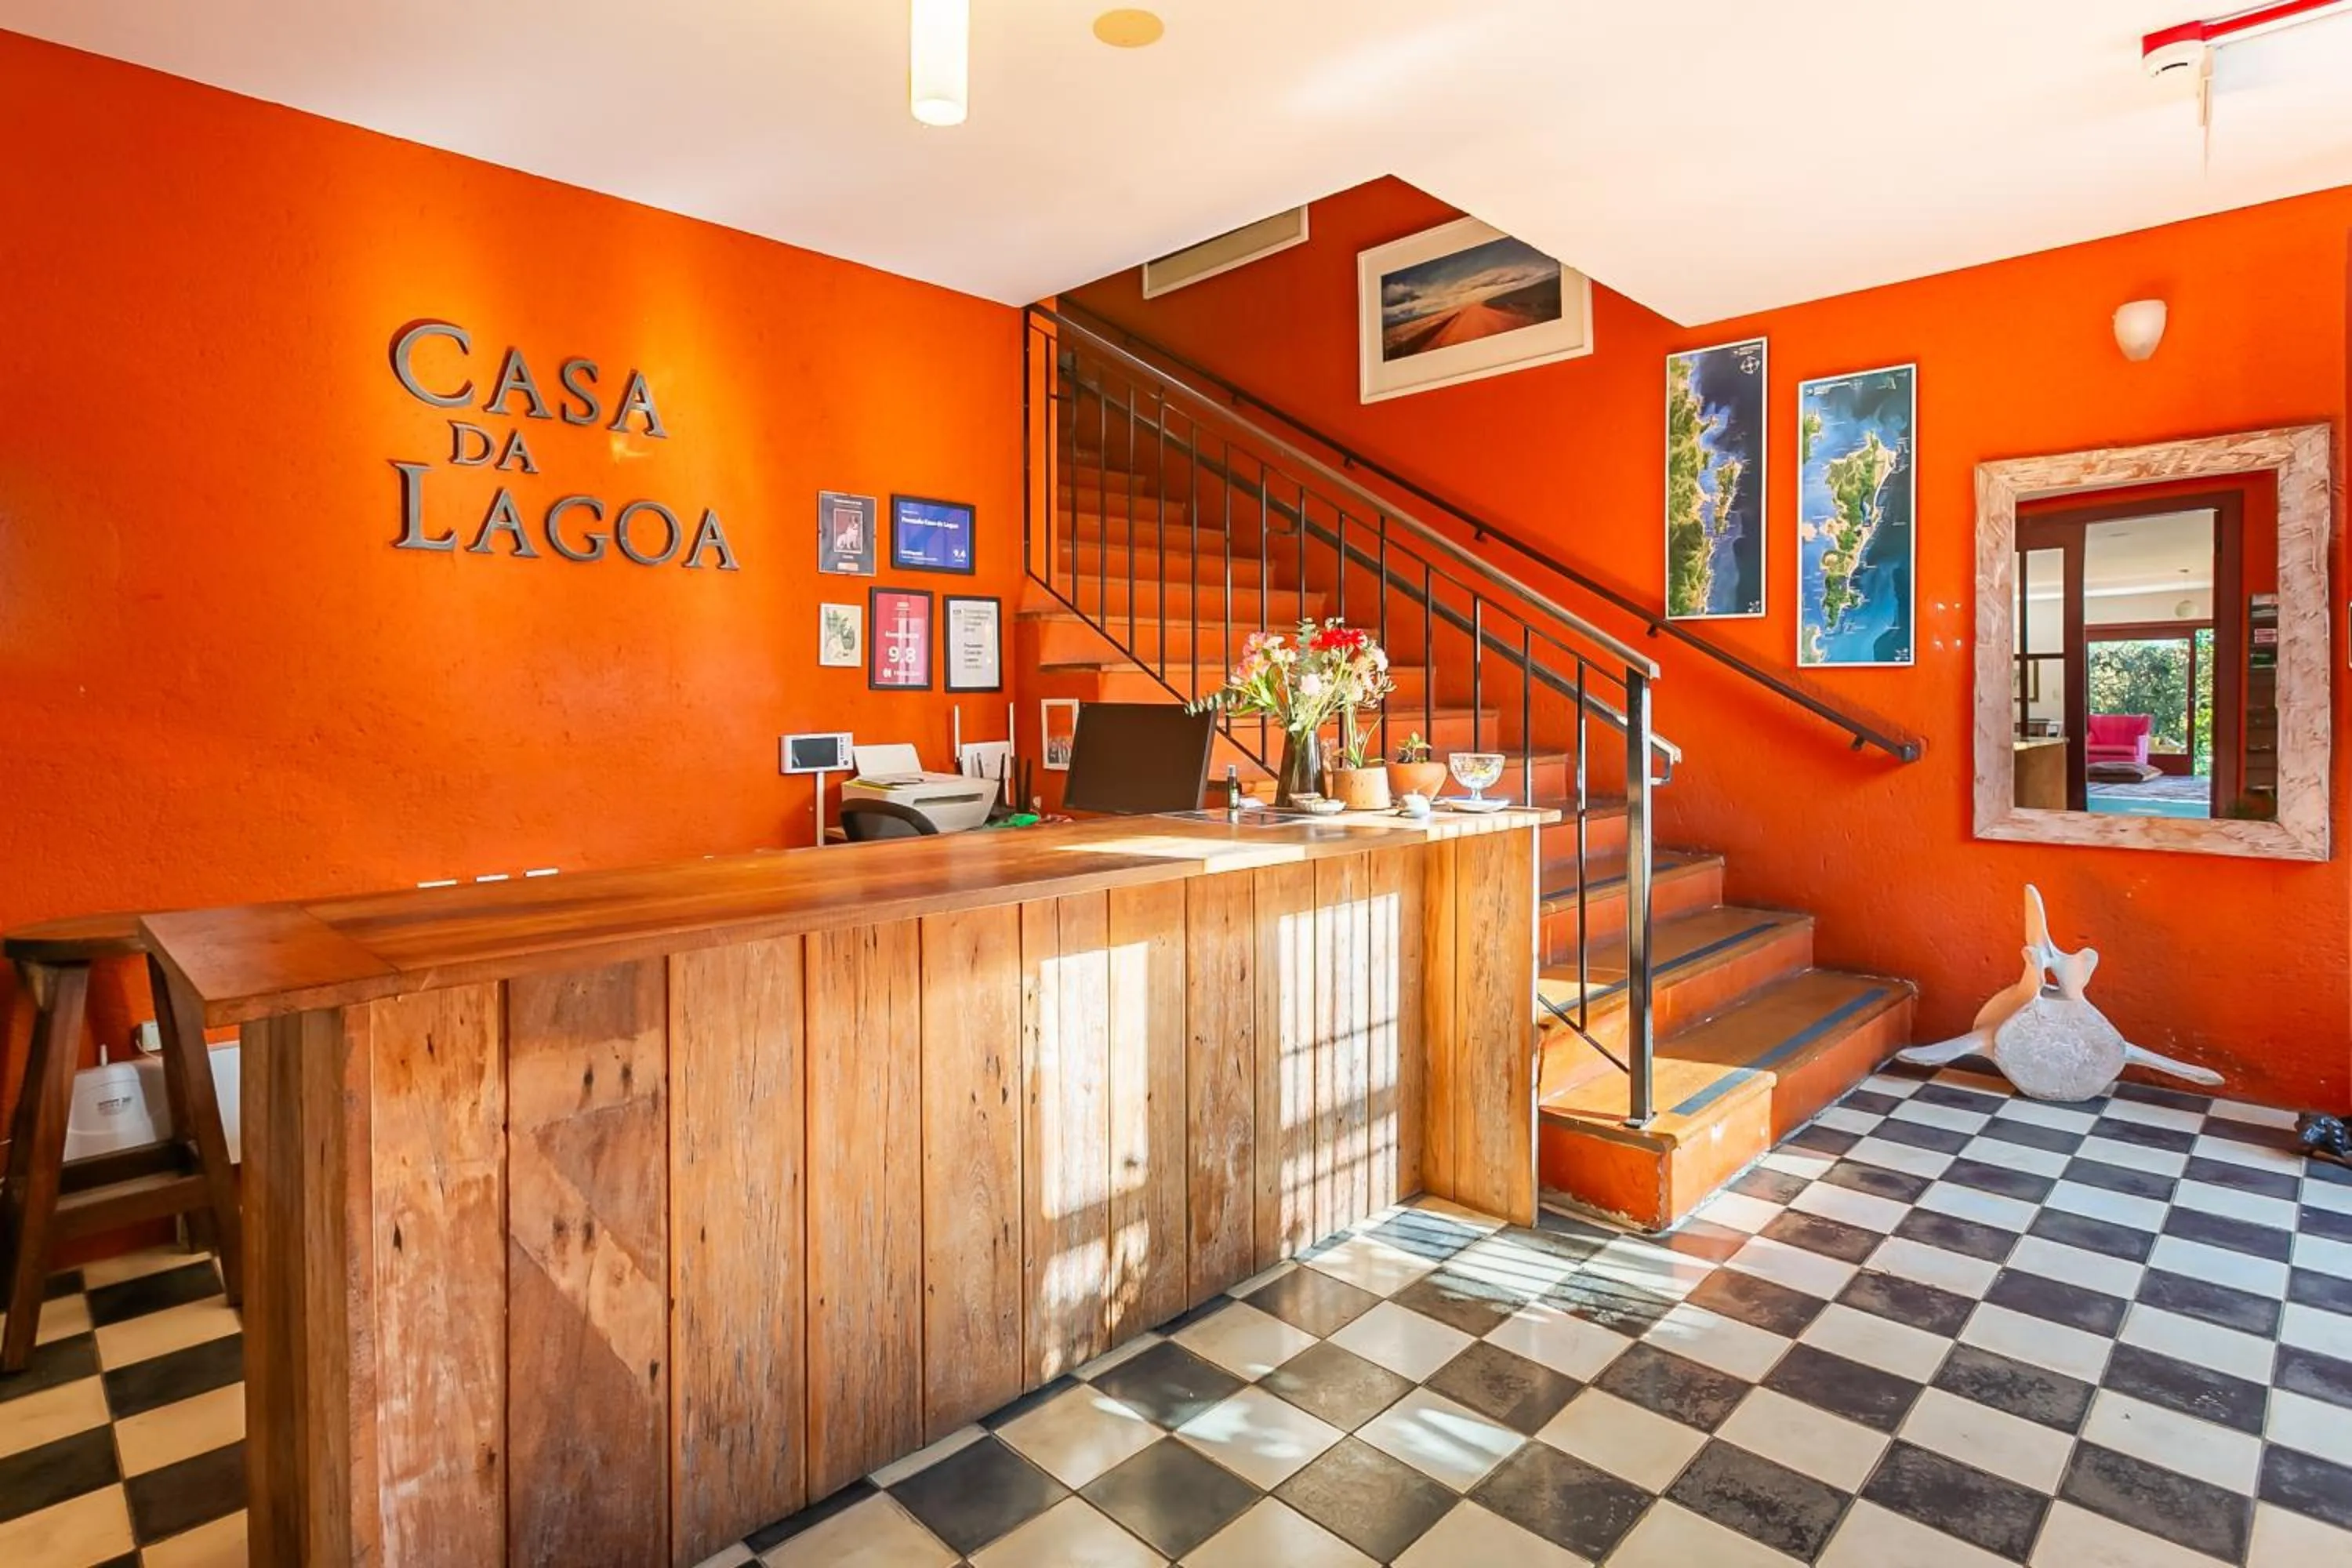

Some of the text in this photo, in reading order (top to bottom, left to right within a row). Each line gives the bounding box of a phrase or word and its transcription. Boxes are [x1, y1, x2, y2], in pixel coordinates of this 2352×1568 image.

[390, 320, 668, 438] CASA
[448, 419, 539, 474] DA
[389, 460, 741, 571] LAGOA
